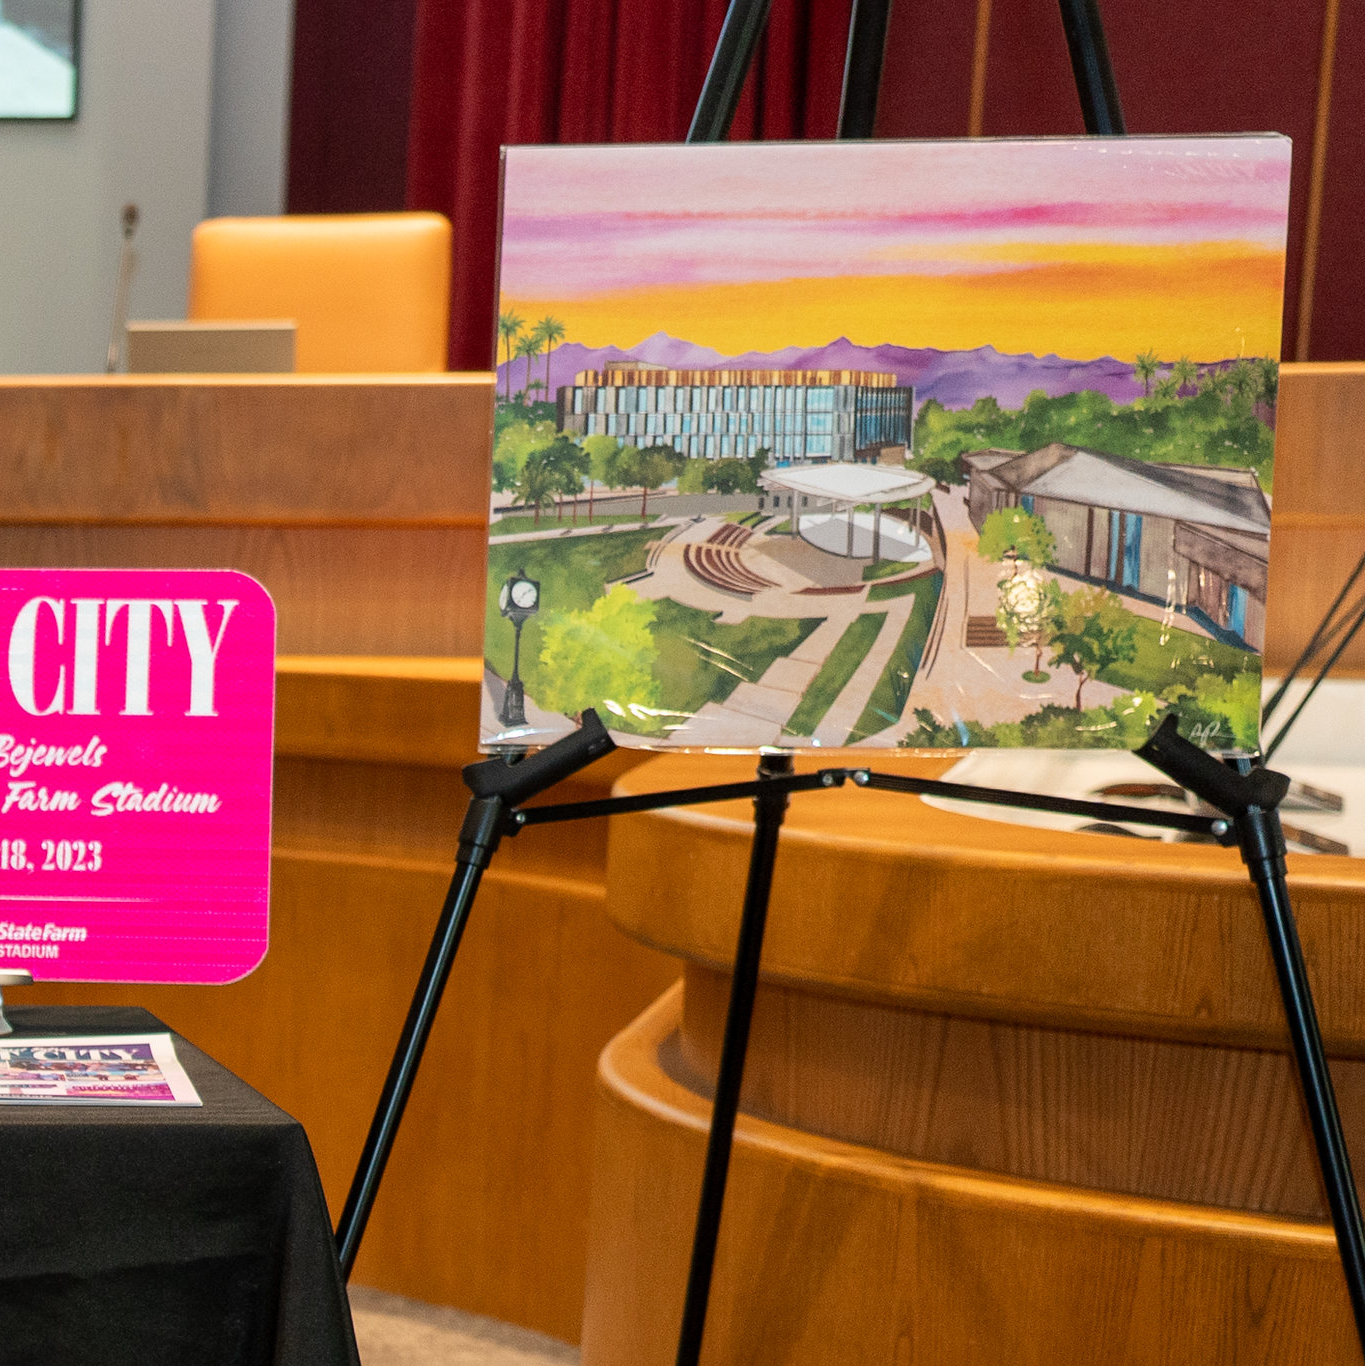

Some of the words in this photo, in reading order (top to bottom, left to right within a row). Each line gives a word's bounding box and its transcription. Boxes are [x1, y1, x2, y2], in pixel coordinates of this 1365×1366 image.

[7, 595, 240, 717] CITY
[1, 781, 81, 814] Farm
[90, 781, 222, 817] Stadium
[41, 839, 103, 872] 2023
[33, 1048, 141, 1061] CITY
